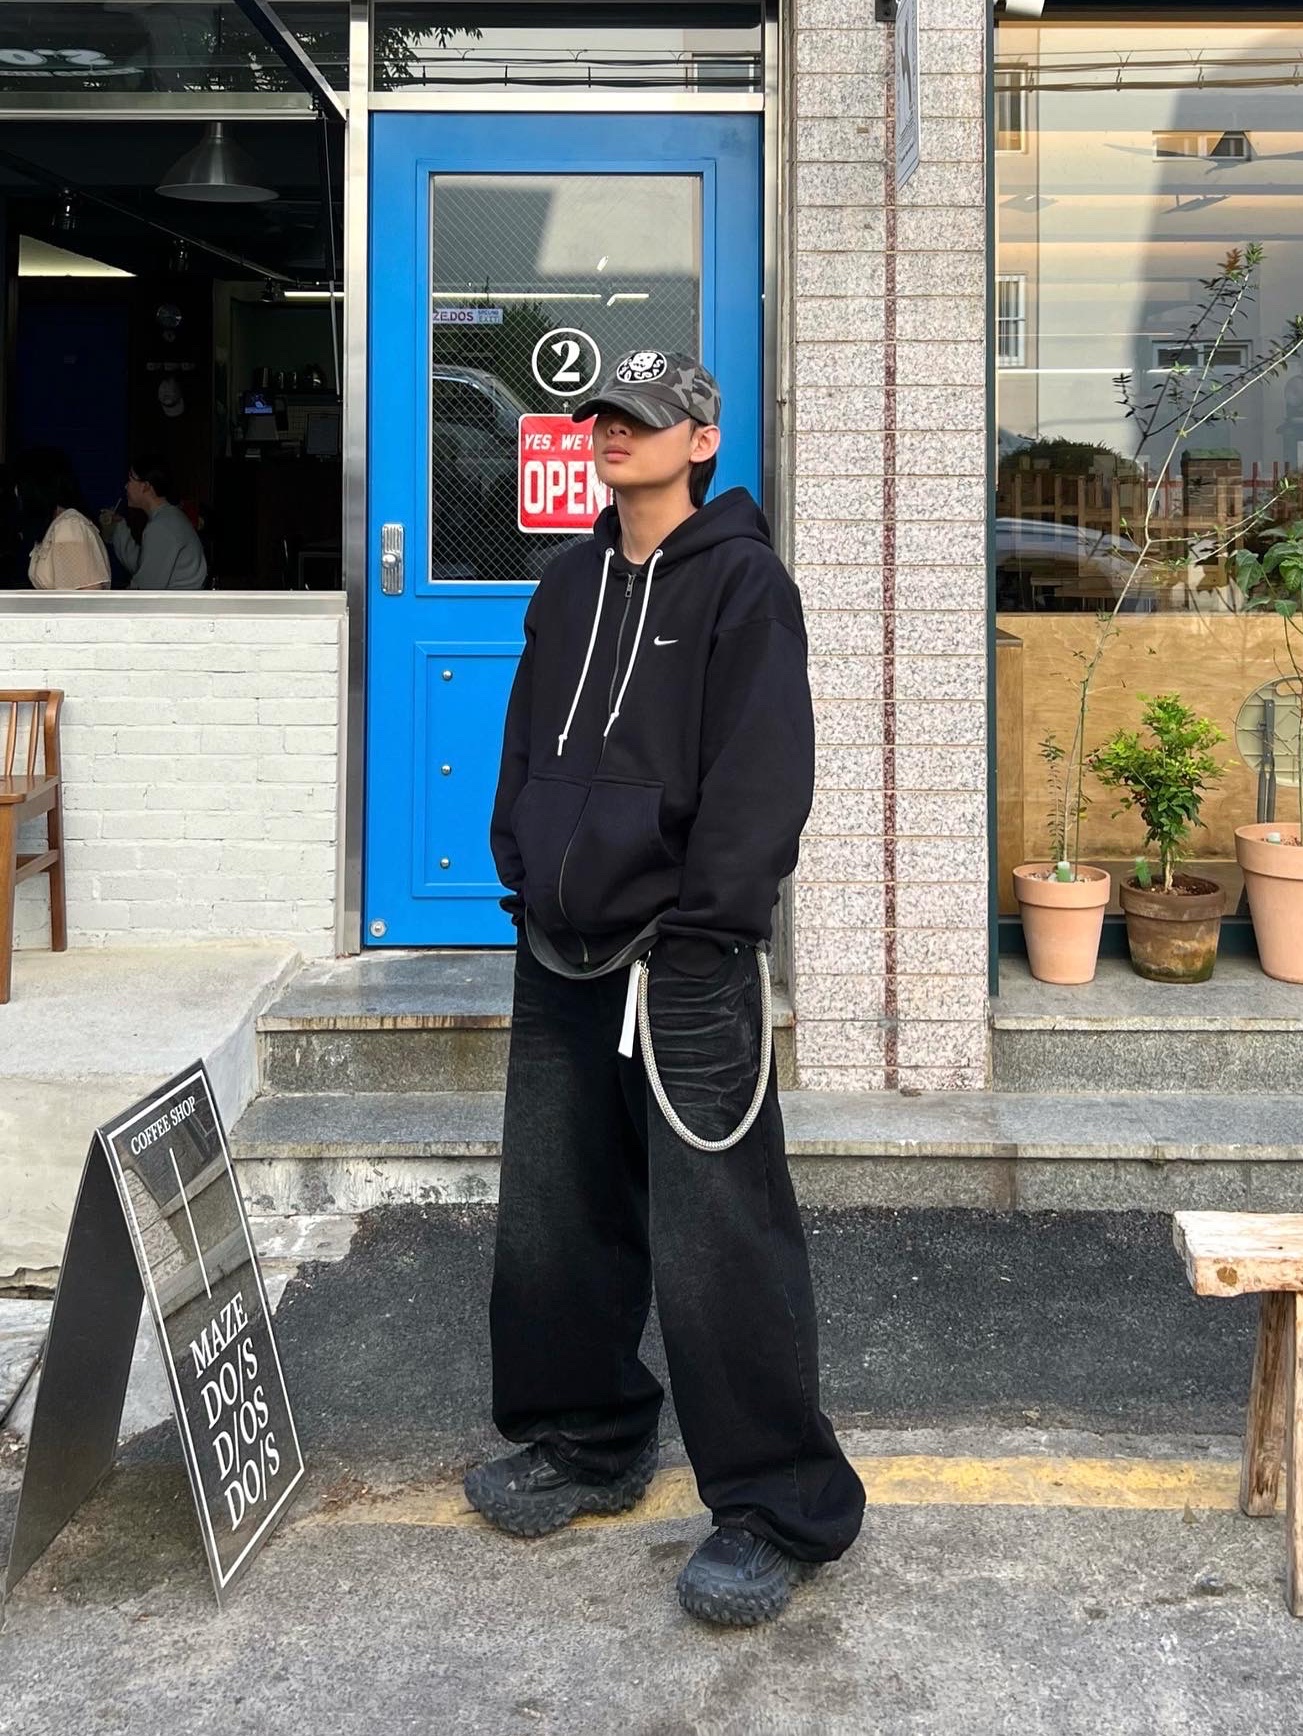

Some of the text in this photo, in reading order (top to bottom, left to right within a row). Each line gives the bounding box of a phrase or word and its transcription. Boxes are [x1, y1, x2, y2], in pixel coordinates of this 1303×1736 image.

[551, 340, 581, 382] 2
[524, 460, 608, 515] OPEN
[131, 1095, 196, 1155] COFFEE SHOP
[189, 1291, 249, 1379] MAZE
[201, 1337, 258, 1430] DO/S
[213, 1385, 269, 1481] D/OS
[224, 1432, 280, 1532] DO/S
